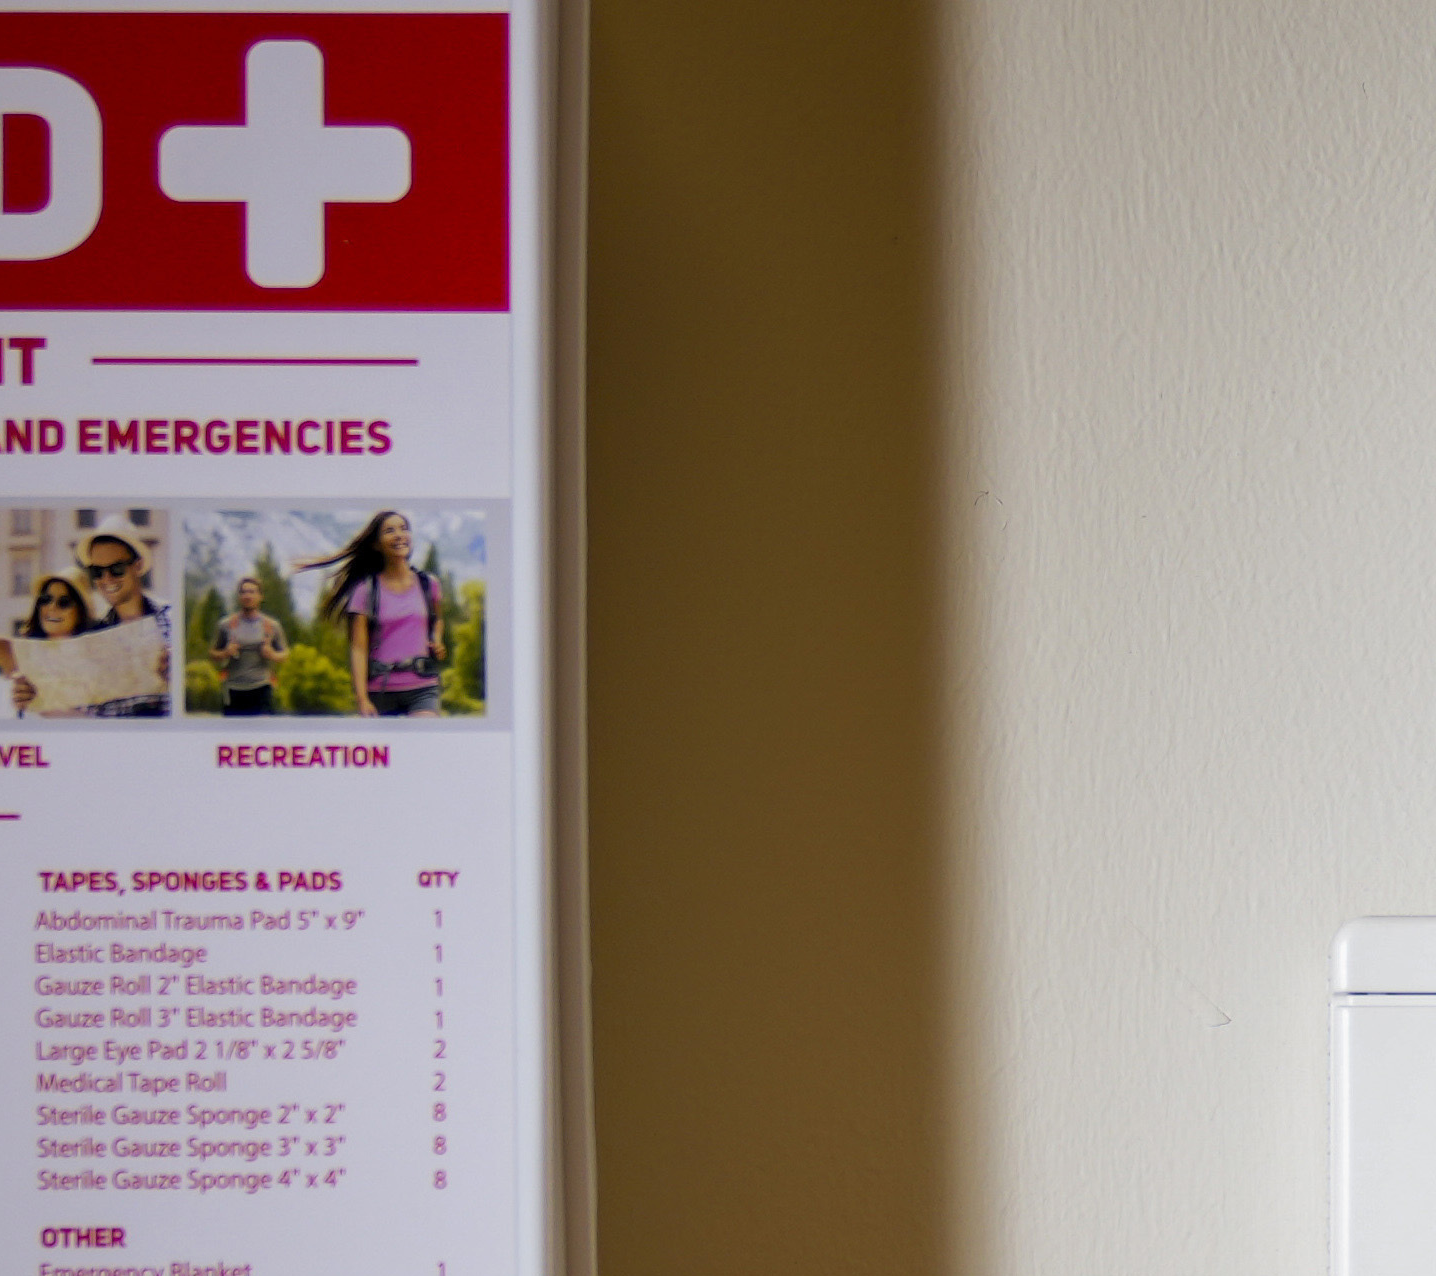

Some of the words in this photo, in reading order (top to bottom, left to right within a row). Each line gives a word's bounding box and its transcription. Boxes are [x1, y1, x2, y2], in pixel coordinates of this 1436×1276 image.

[76, 419, 392, 456] EMERGENCIES
[217, 745, 390, 768] RECREATION
[38, 871, 126, 897] TAPES,
[131, 870, 249, 892] SPONGES
[254, 871, 271, 892] &
[277, 871, 343, 892] PADS
[40, 1227, 126, 1249] OTHER
